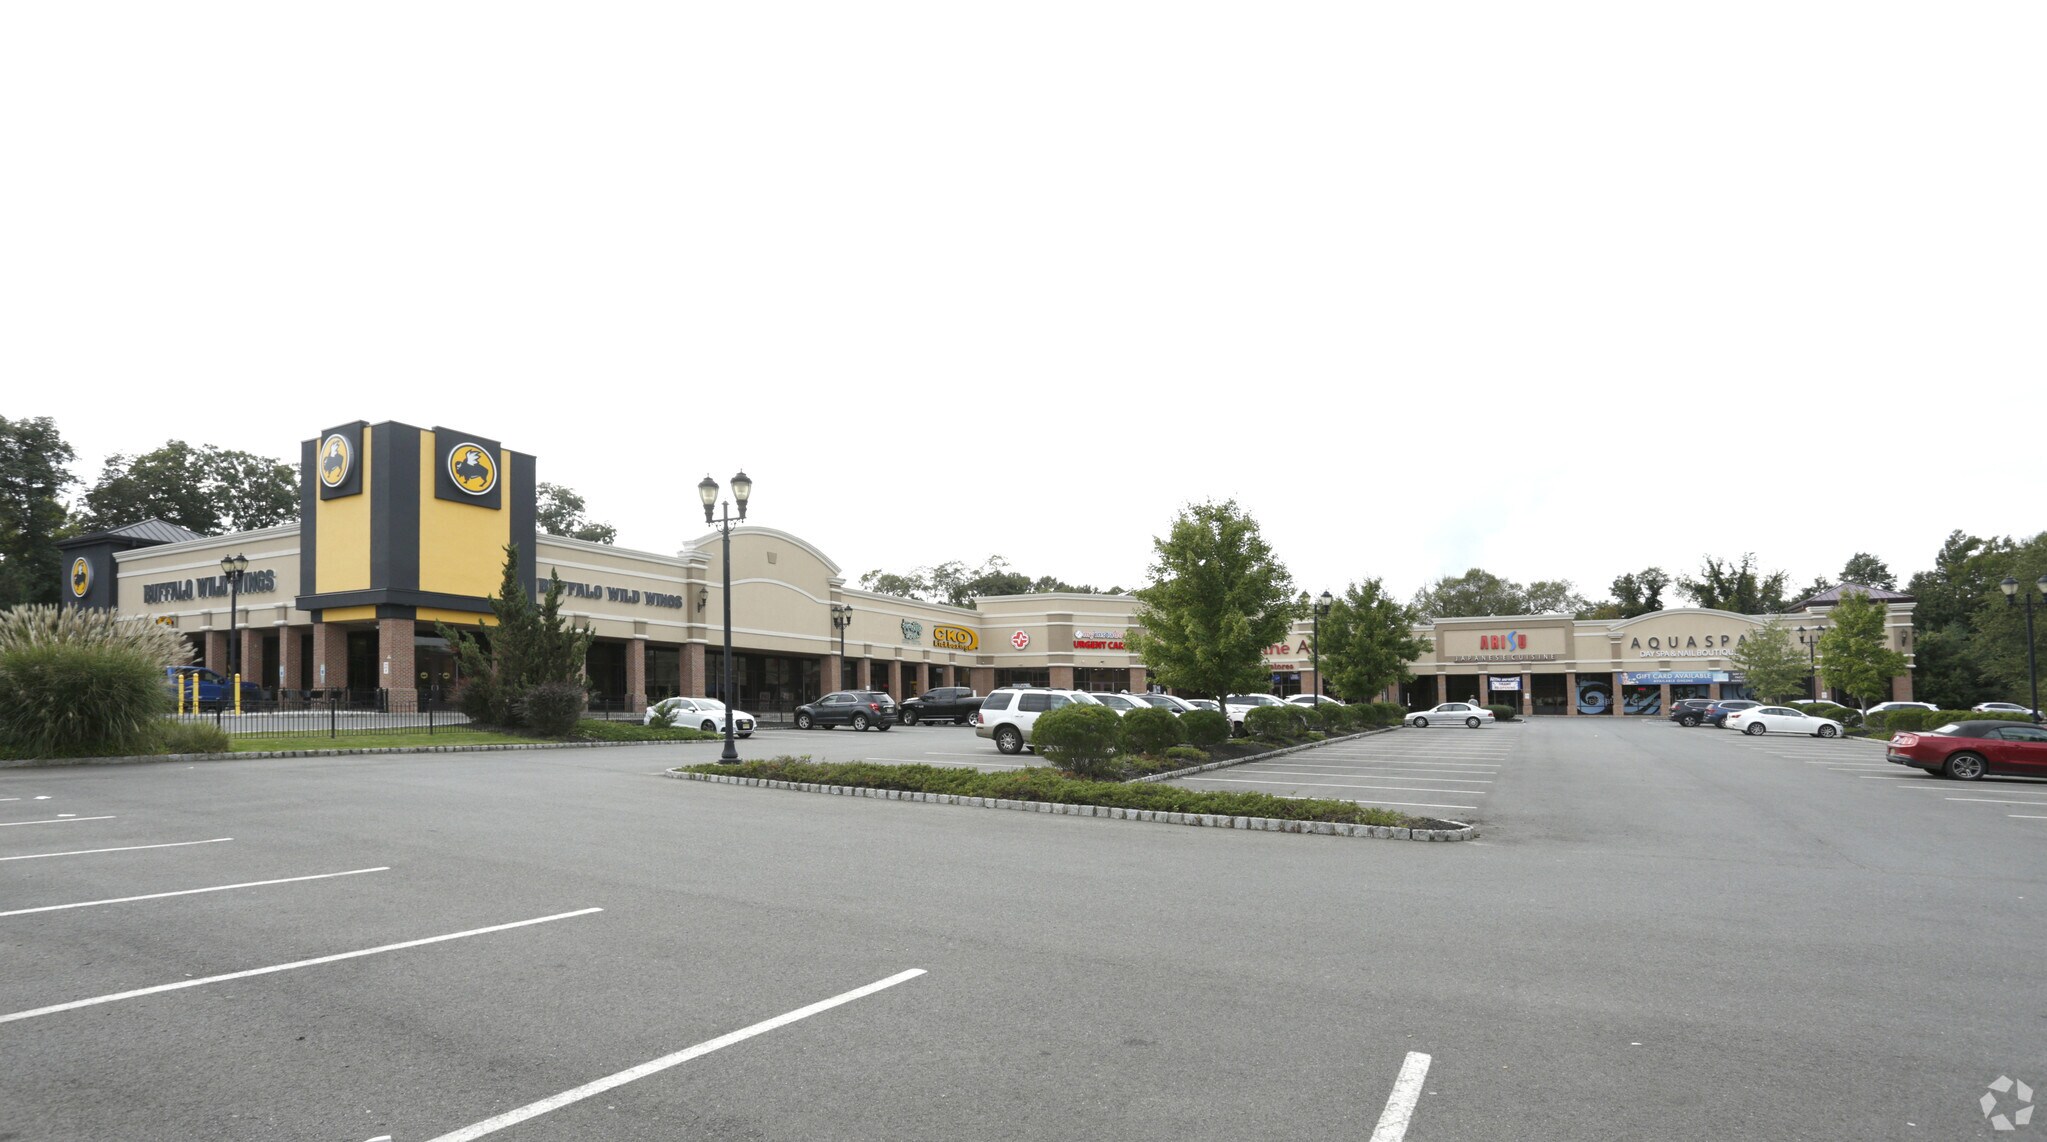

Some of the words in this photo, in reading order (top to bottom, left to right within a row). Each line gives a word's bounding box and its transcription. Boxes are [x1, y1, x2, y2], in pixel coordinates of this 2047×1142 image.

[143, 579, 196, 604] BUFFALO
[196, 574, 230, 598] WILD
[233, 569, 277, 594] WINGS
[606, 586, 641, 604] WILD
[644, 591, 683, 609] WINGS
[933, 627, 970, 644] CKO
[1480, 630, 1527, 652] ARISU
[1631, 635, 1747, 650] AQUASPA
[1073, 640, 1107, 649] URGENT
[1108, 641, 1125, 650] CAR
[1296, 639, 1311, 655] A
[1454, 654, 1507, 662] JAPANESE
[1511, 653, 1556, 661] CUISINE
[1677, 649, 1696, 657] NAIL
[1635, 672, 1651, 680] GIFT
[1652, 672, 1673, 680] CARD
